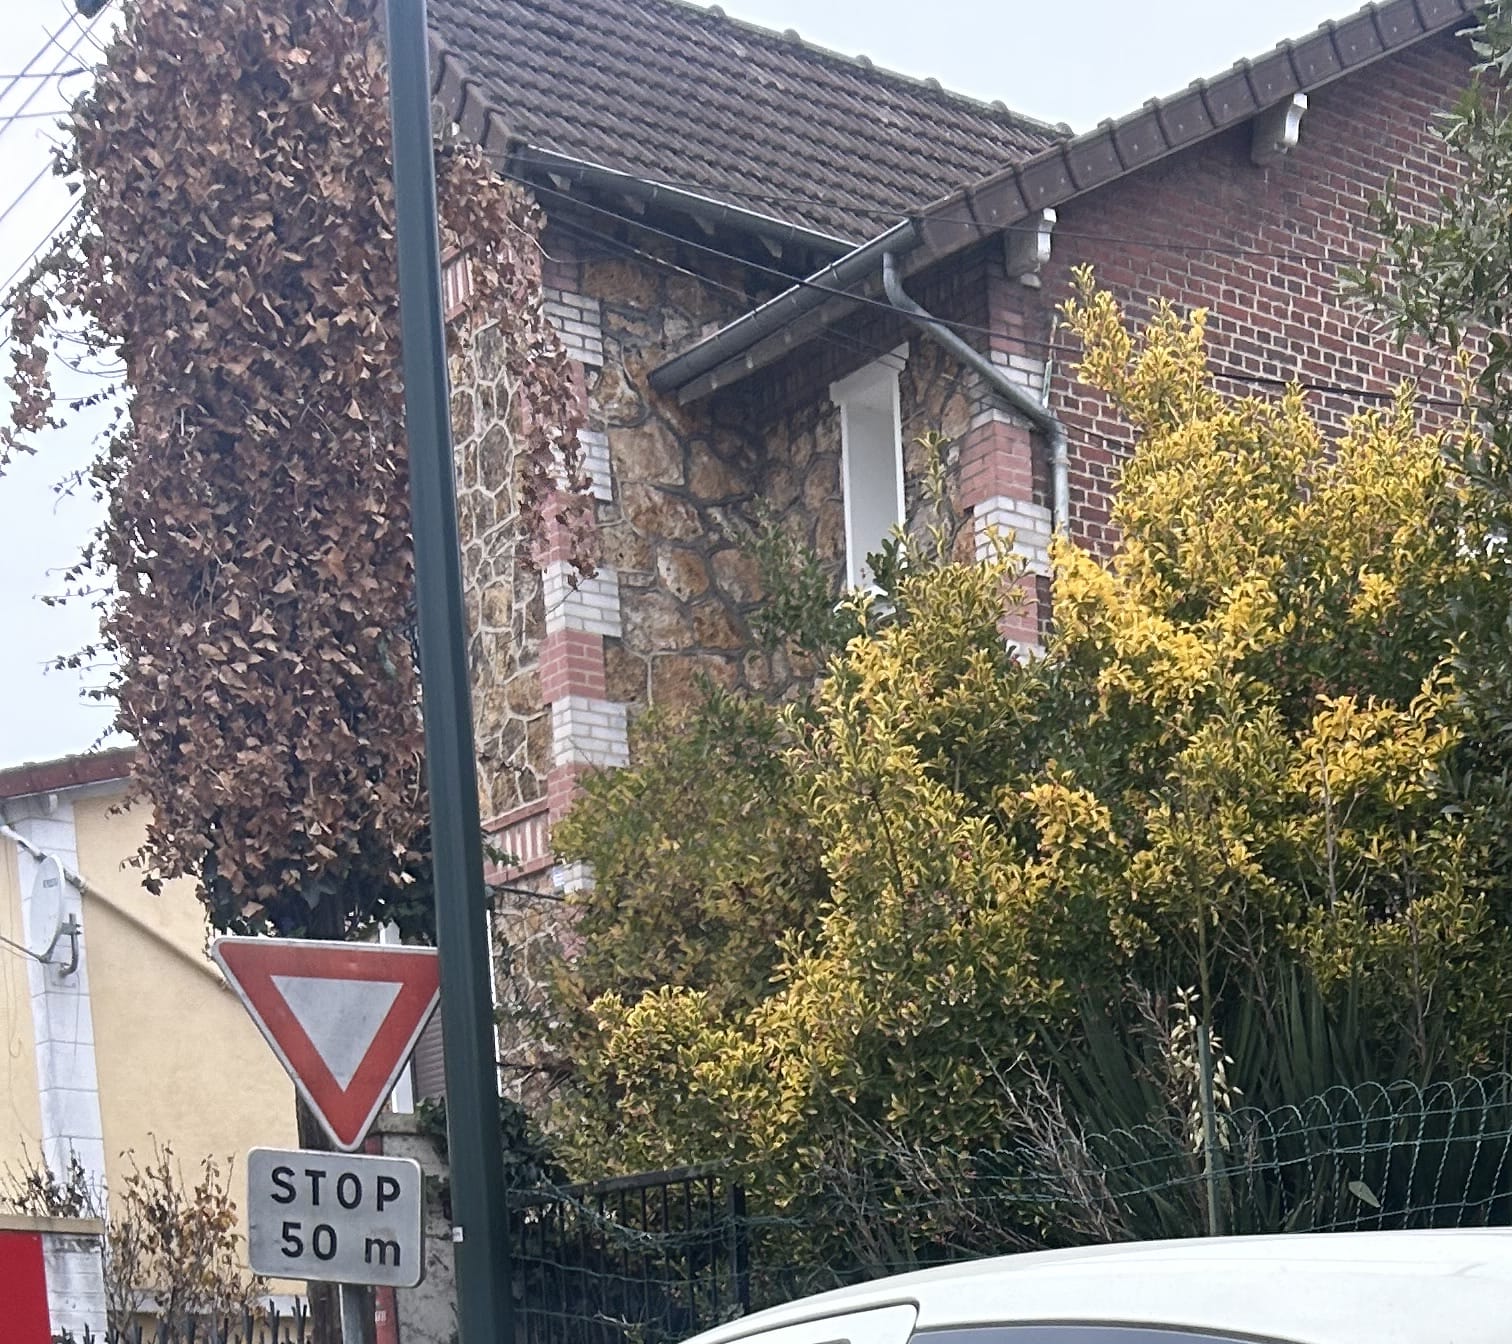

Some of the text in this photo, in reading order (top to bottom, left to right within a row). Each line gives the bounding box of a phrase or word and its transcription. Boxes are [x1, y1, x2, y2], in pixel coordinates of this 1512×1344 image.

[270, 1166, 401, 1212] STOP
[281, 1221, 401, 1267] 50 m
